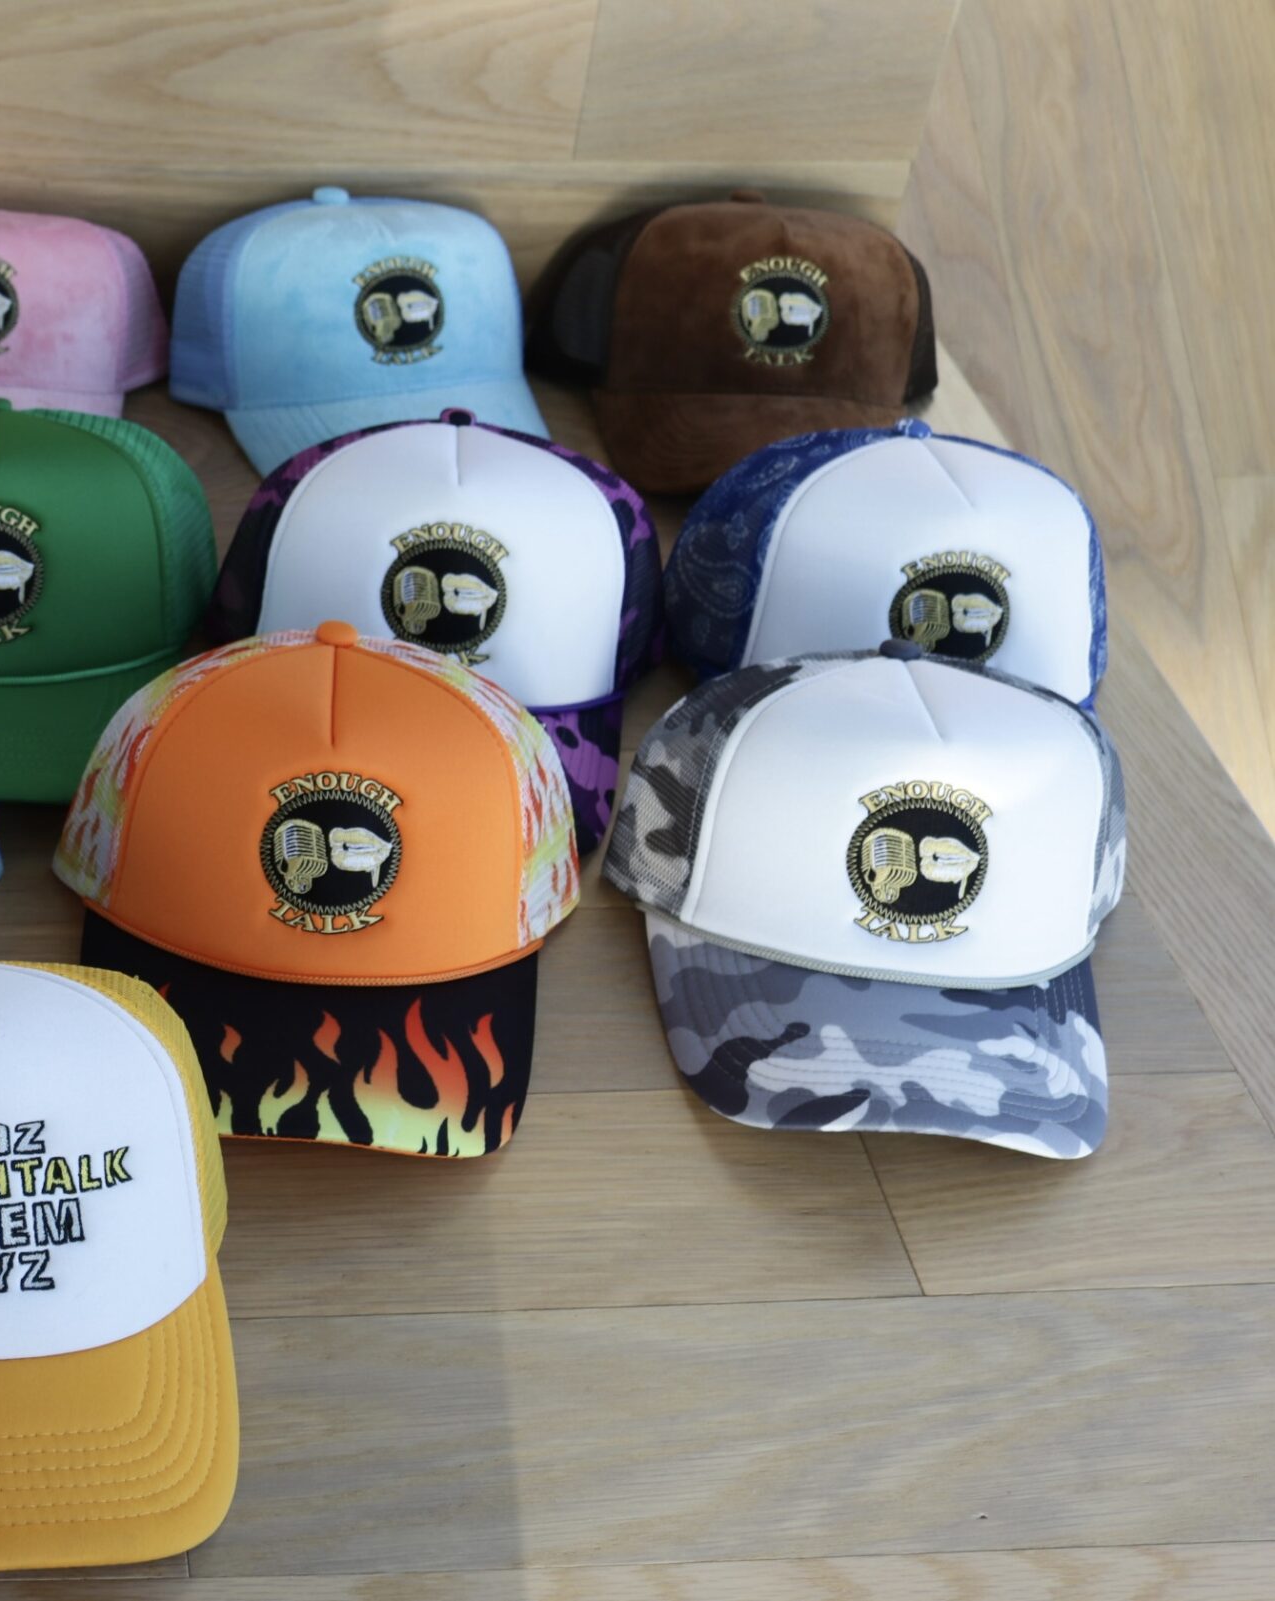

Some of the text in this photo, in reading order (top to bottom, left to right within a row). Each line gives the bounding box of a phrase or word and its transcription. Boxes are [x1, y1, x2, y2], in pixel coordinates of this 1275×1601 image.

[739, 255, 829, 287] ENOUGH
[392, 521, 509, 562] ENOUGH
[901, 551, 1011, 584] ENOUGH
[269, 770, 403, 815] ENOUGH
[858, 780, 993, 825] ENOUGH
[268, 896, 383, 934] TALK
[853, 905, 968, 943] TALK
